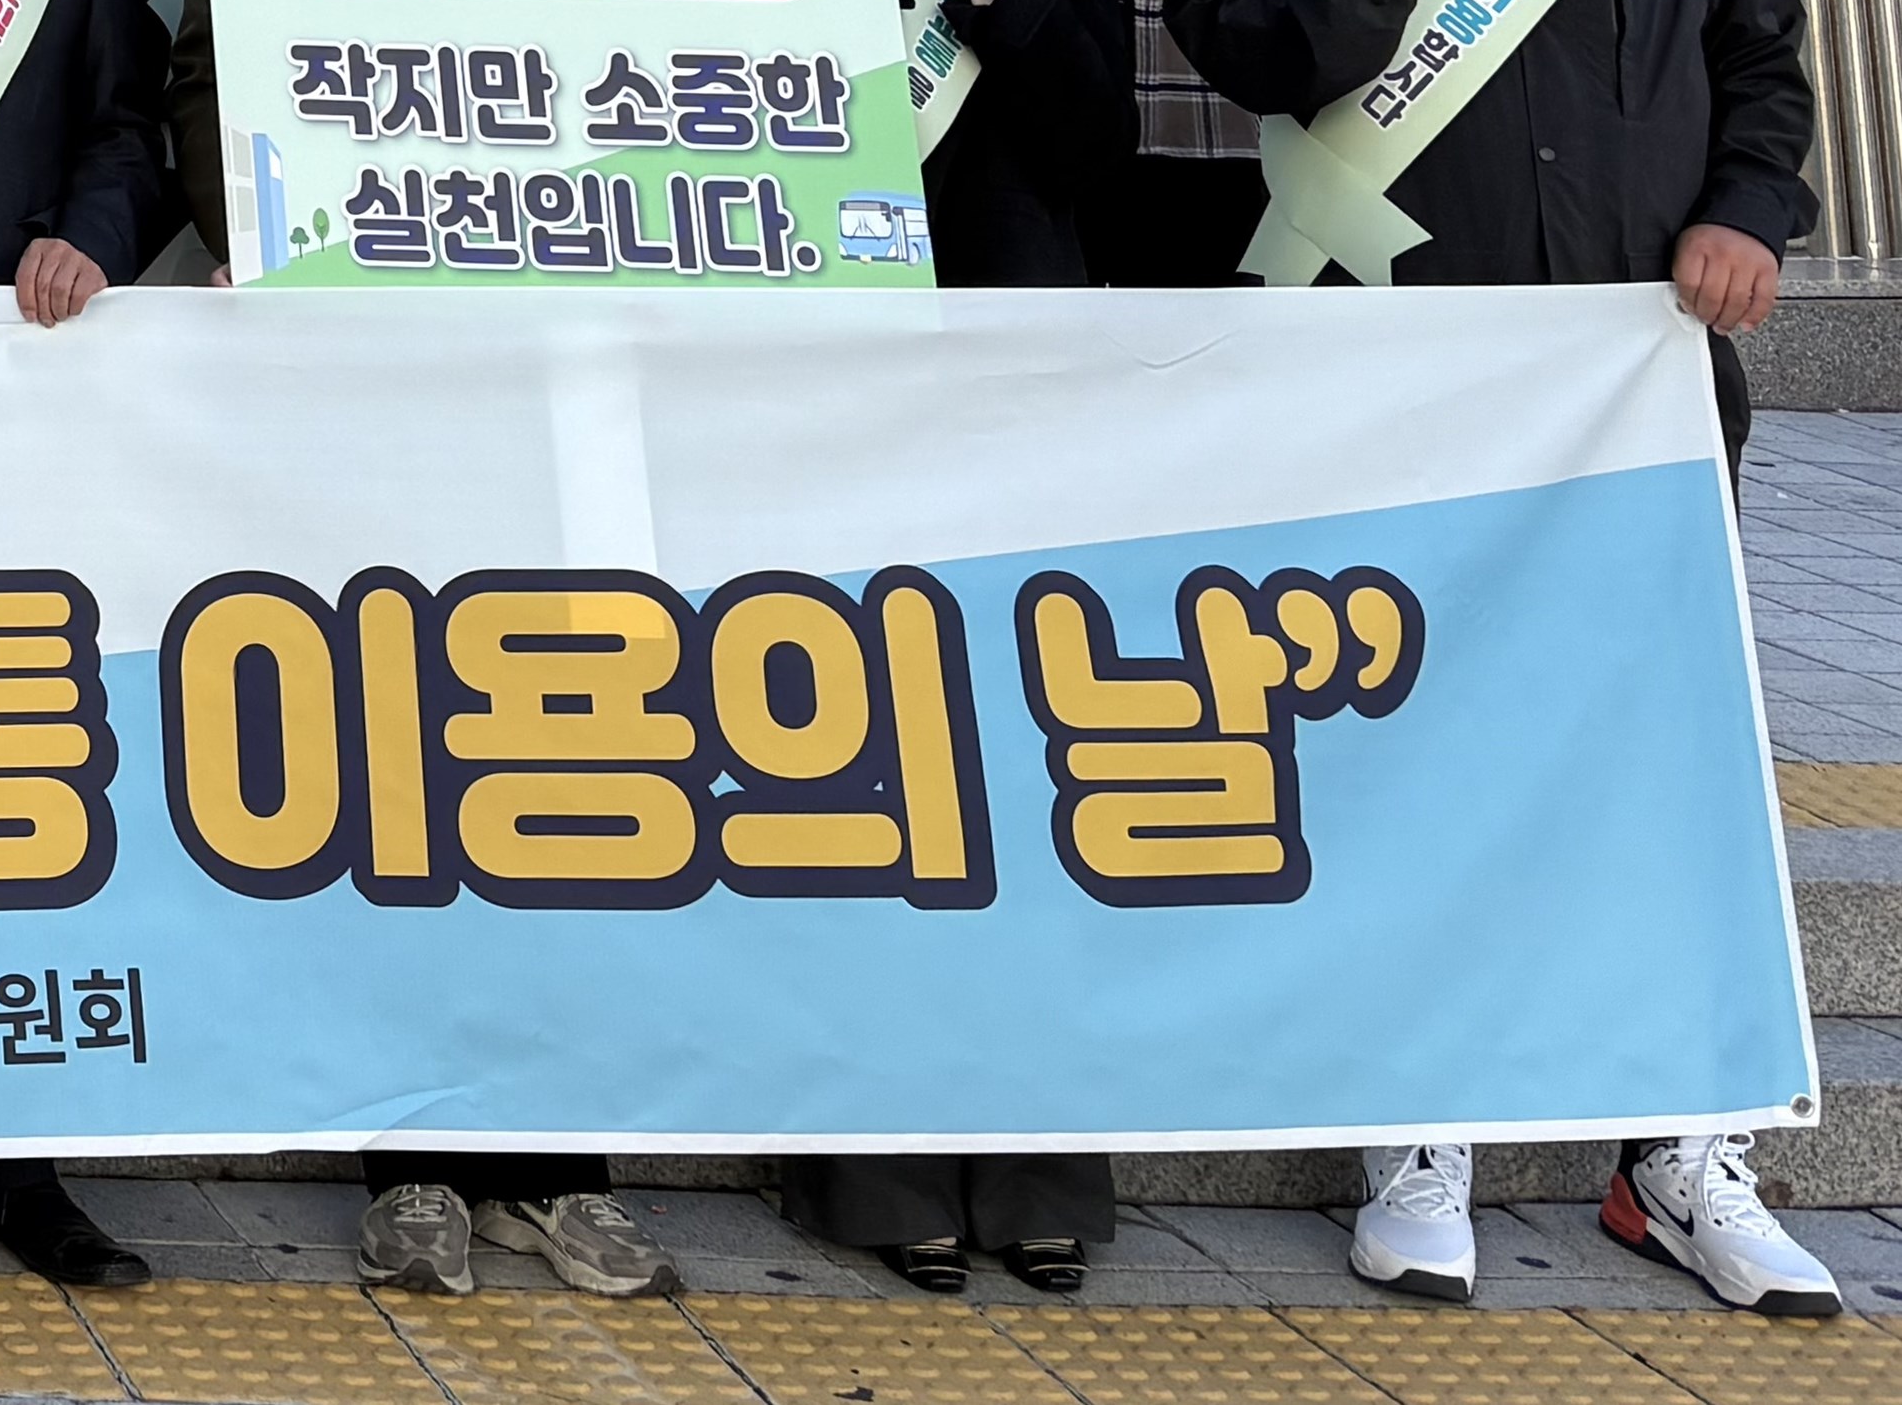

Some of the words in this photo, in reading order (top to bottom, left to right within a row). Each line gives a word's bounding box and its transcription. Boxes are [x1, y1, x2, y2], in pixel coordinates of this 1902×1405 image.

[287, 38, 557, 145] 작지만
[583, 47, 852, 153] 소중한
[345, 164, 823, 275] 실천입니다.
[166, 570, 991, 903] 이용의
